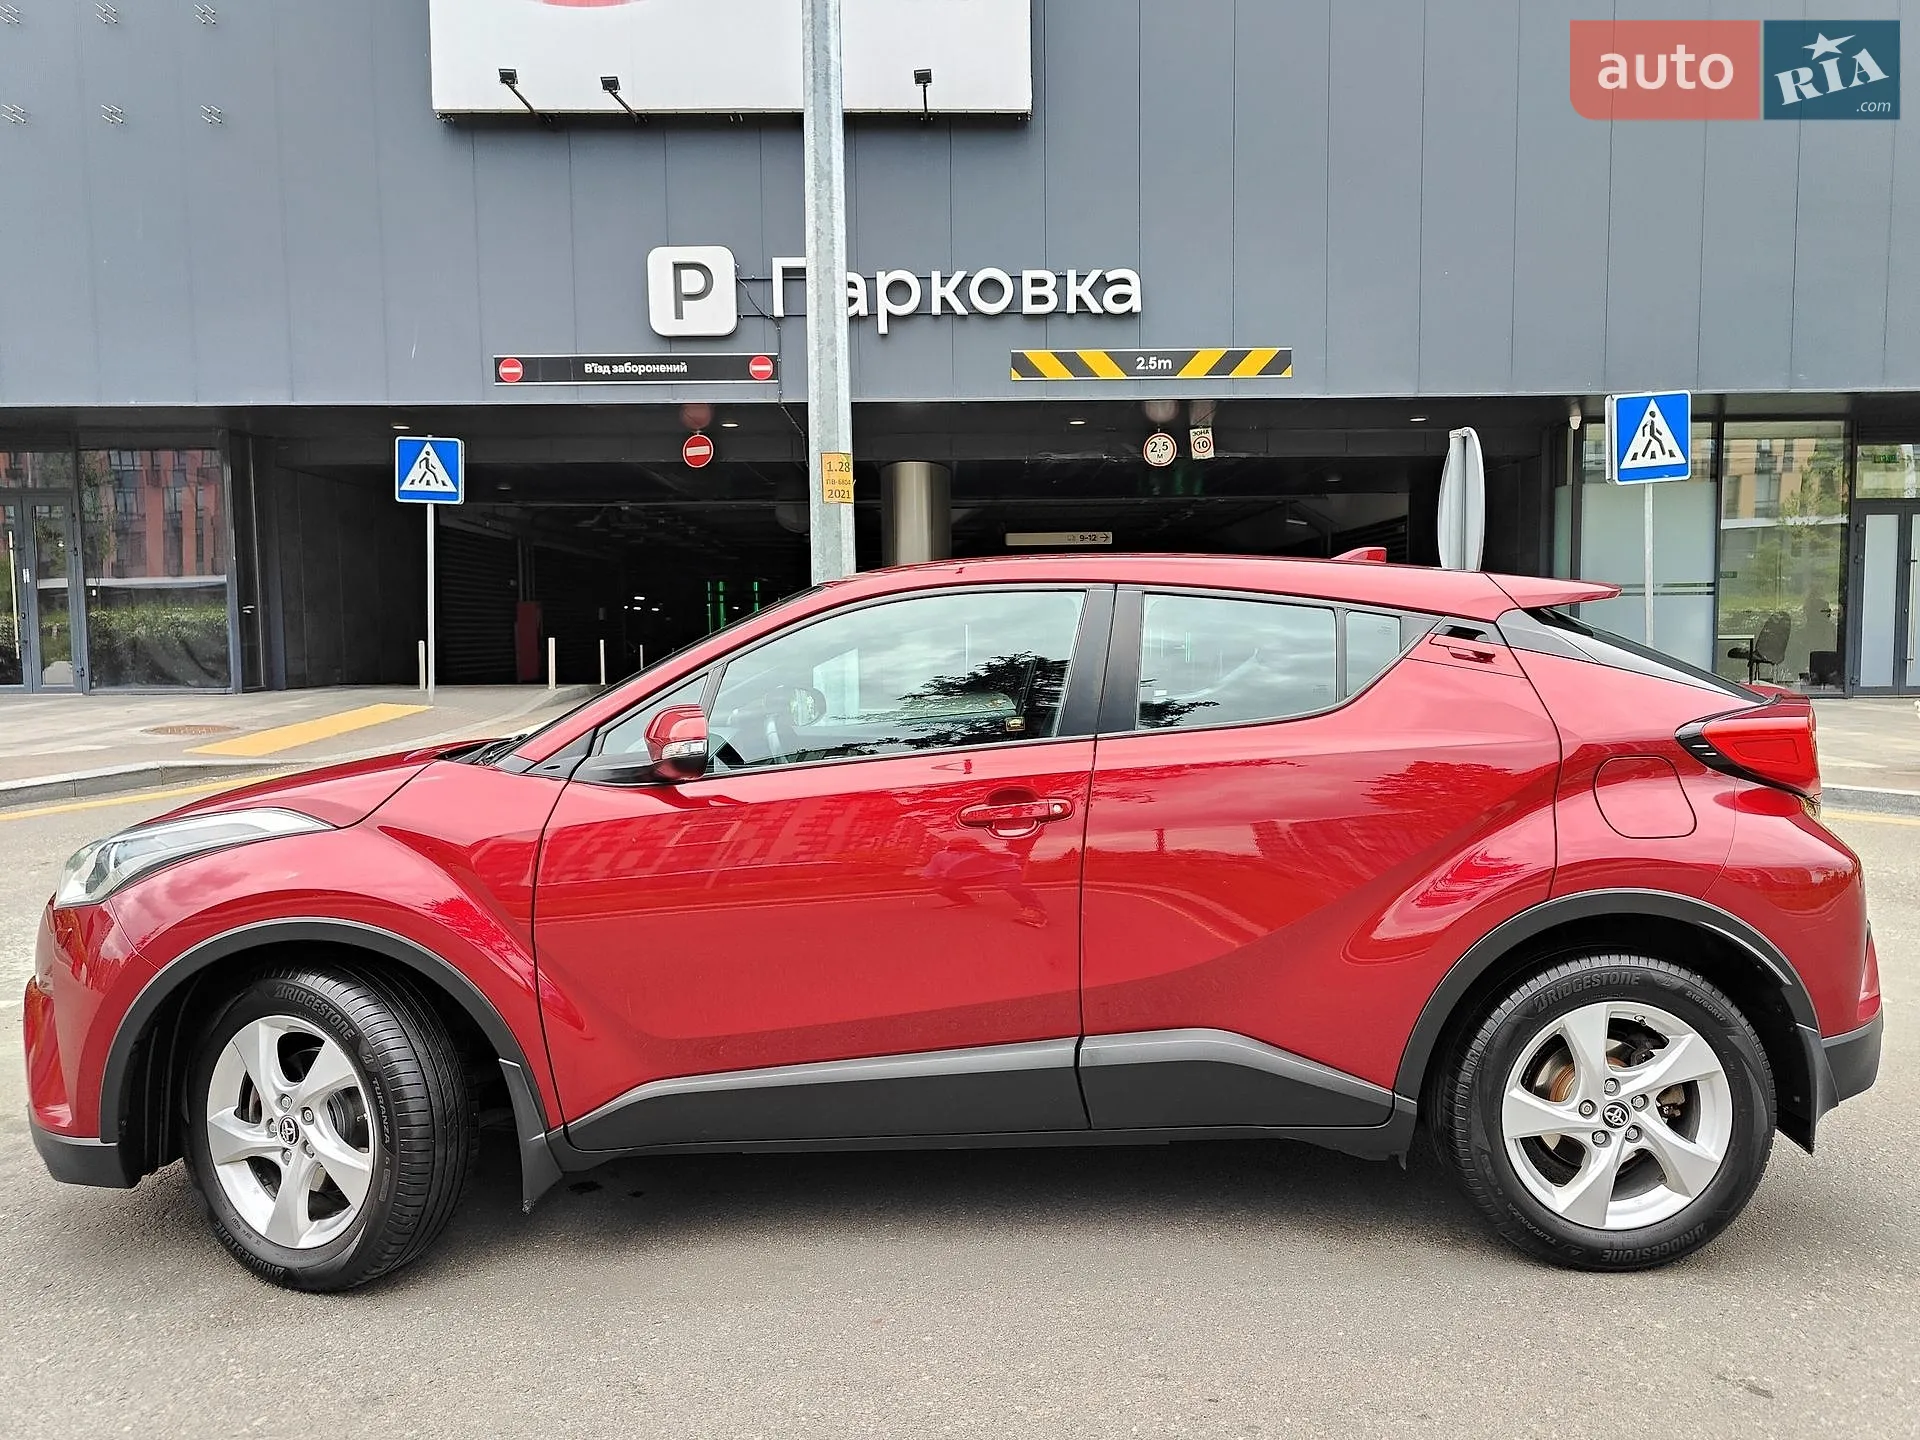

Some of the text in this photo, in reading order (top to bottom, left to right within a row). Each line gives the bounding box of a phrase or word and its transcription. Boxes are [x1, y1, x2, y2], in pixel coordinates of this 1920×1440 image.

[672, 261, 714, 320] P
[612, 362, 688, 374] заборонений
[1136, 356, 1172, 370] 2.5m
[1192, 429, 1210, 437] ЗОНА
[1149, 441, 1169, 453] 2,5
[1196, 440, 1208, 449] 10
[826, 461, 851, 473] 1.28
[827, 489, 851, 499] 2021
[1079, 534, 1097, 542] 9-12
[1533, 971, 1642, 1013] BRIDGESTONE
[273, 983, 356, 1041] BRIDGESTONE
[372, 1076, 392, 1145] TURANZA
